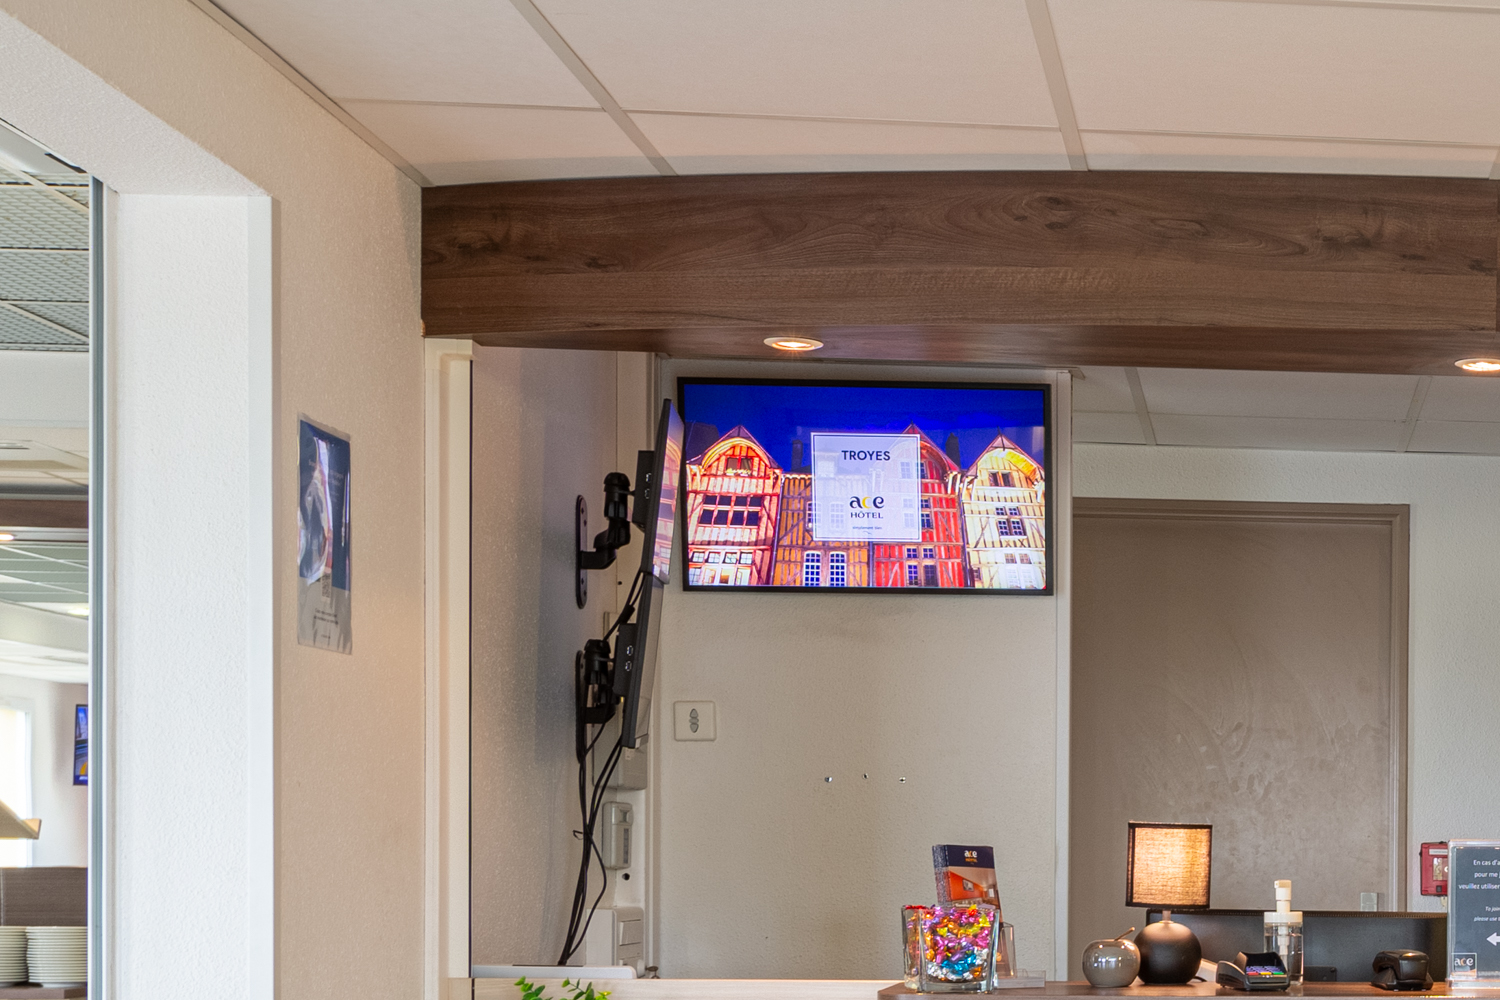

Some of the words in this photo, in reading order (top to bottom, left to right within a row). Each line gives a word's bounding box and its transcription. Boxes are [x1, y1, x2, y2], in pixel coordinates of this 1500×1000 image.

[841, 450, 891, 461] TROYES
[849, 496, 885, 509] ace
[850, 511, 884, 519] HÔTEL
[1454, 957, 1474, 966] ace
